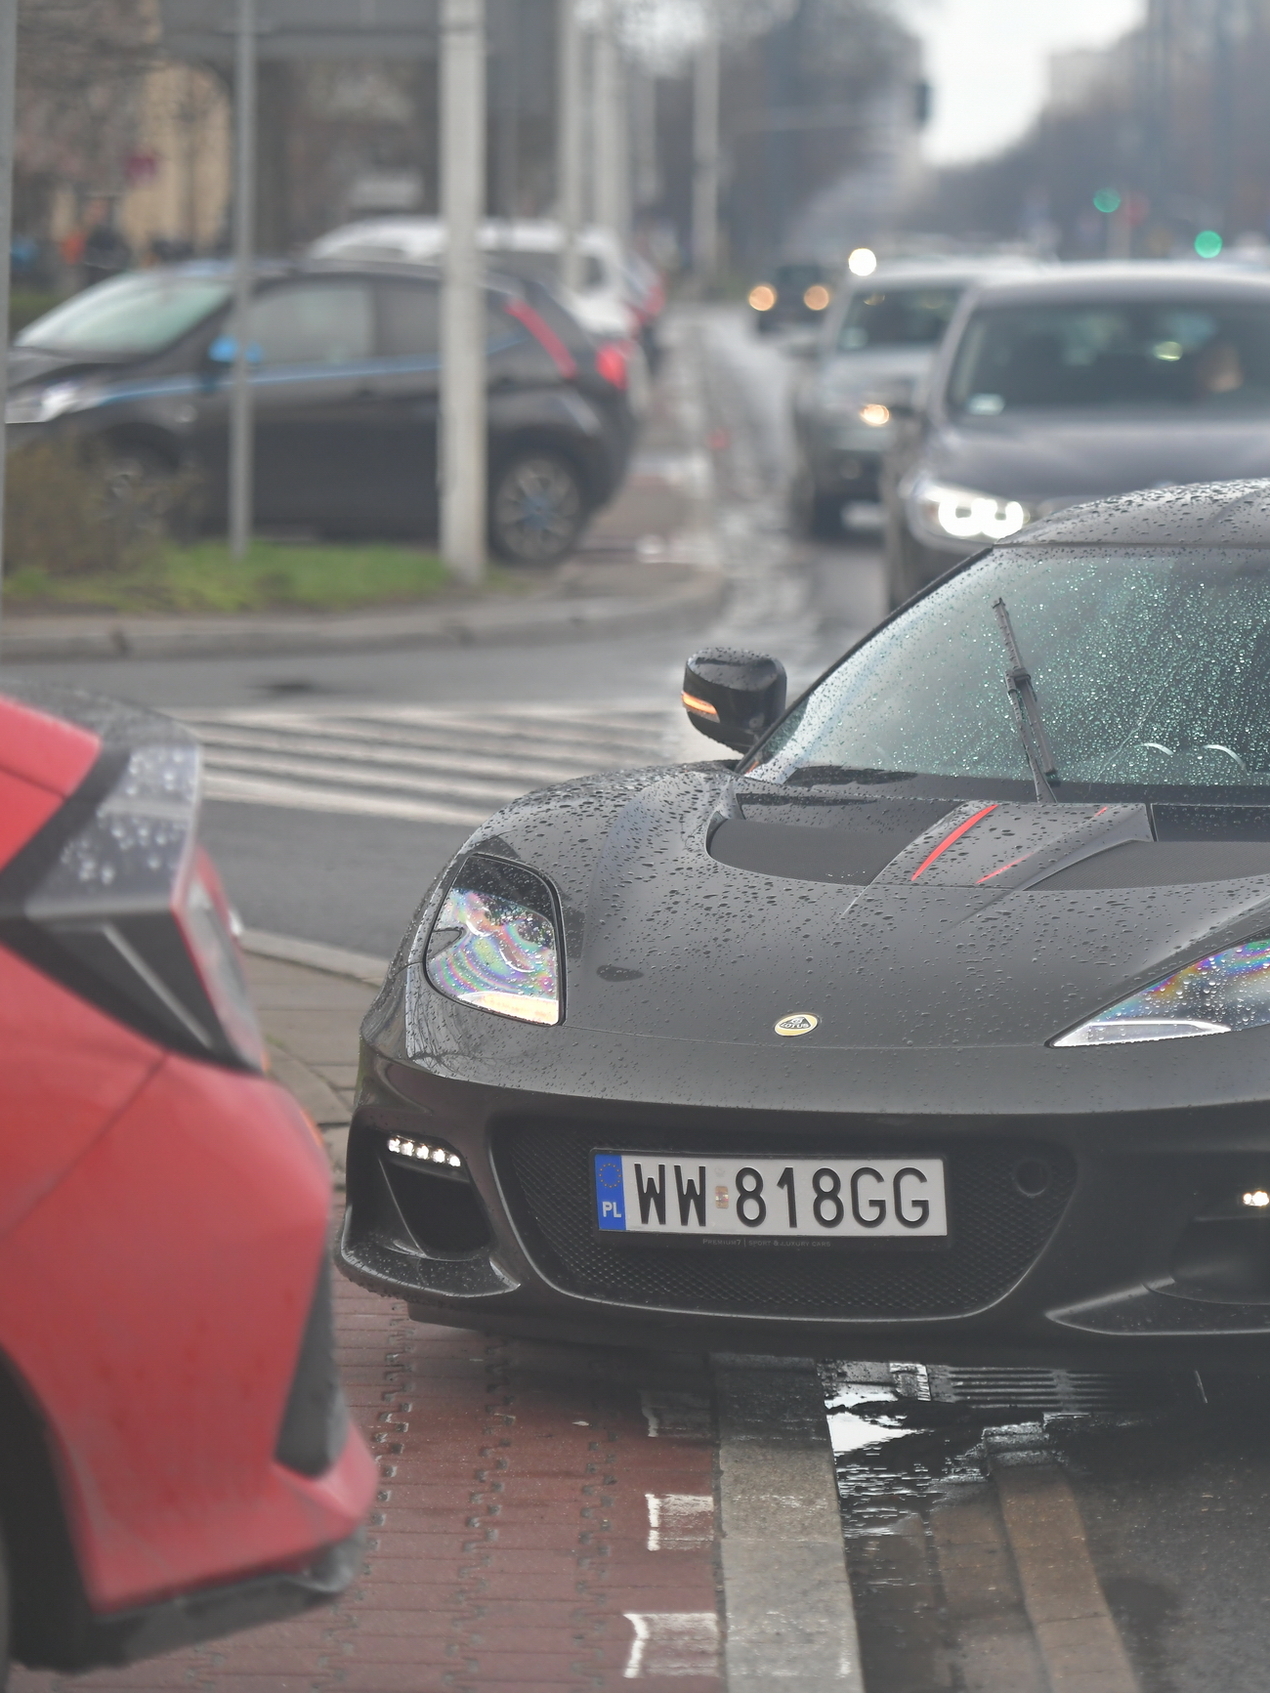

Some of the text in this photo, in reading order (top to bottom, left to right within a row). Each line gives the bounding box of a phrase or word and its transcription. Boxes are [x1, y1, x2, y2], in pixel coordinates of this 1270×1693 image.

[634, 1163, 930, 1229] WW 818GG
[602, 1201, 622, 1218] PL
[748, 1239, 772, 1248] SPORT
[811, 1240, 832, 1248] CARS
